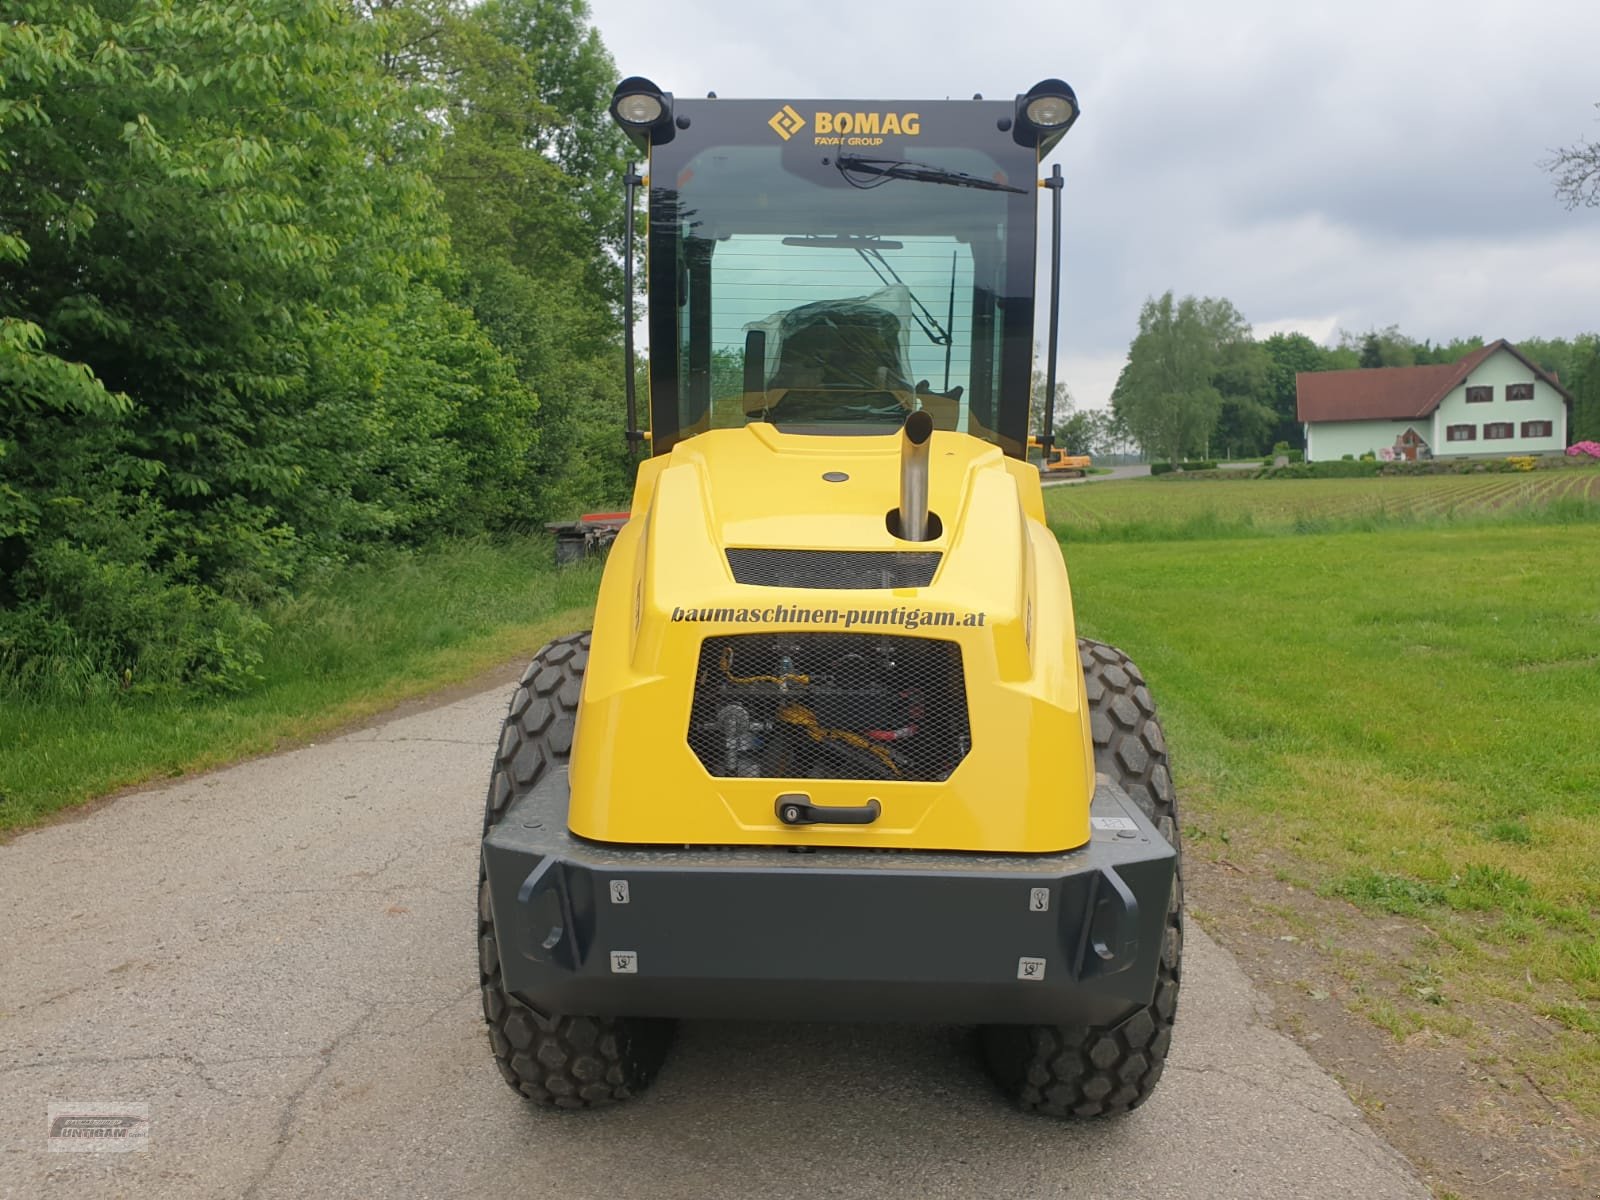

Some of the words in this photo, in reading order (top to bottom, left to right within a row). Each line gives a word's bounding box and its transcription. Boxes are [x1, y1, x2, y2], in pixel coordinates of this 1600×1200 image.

[815, 112, 920, 135] BOMAG
[815, 137, 845, 145] FAYAT
[848, 137, 883, 146] GROUP
[671, 605, 985, 629] baumaschinen-puntigam.at
